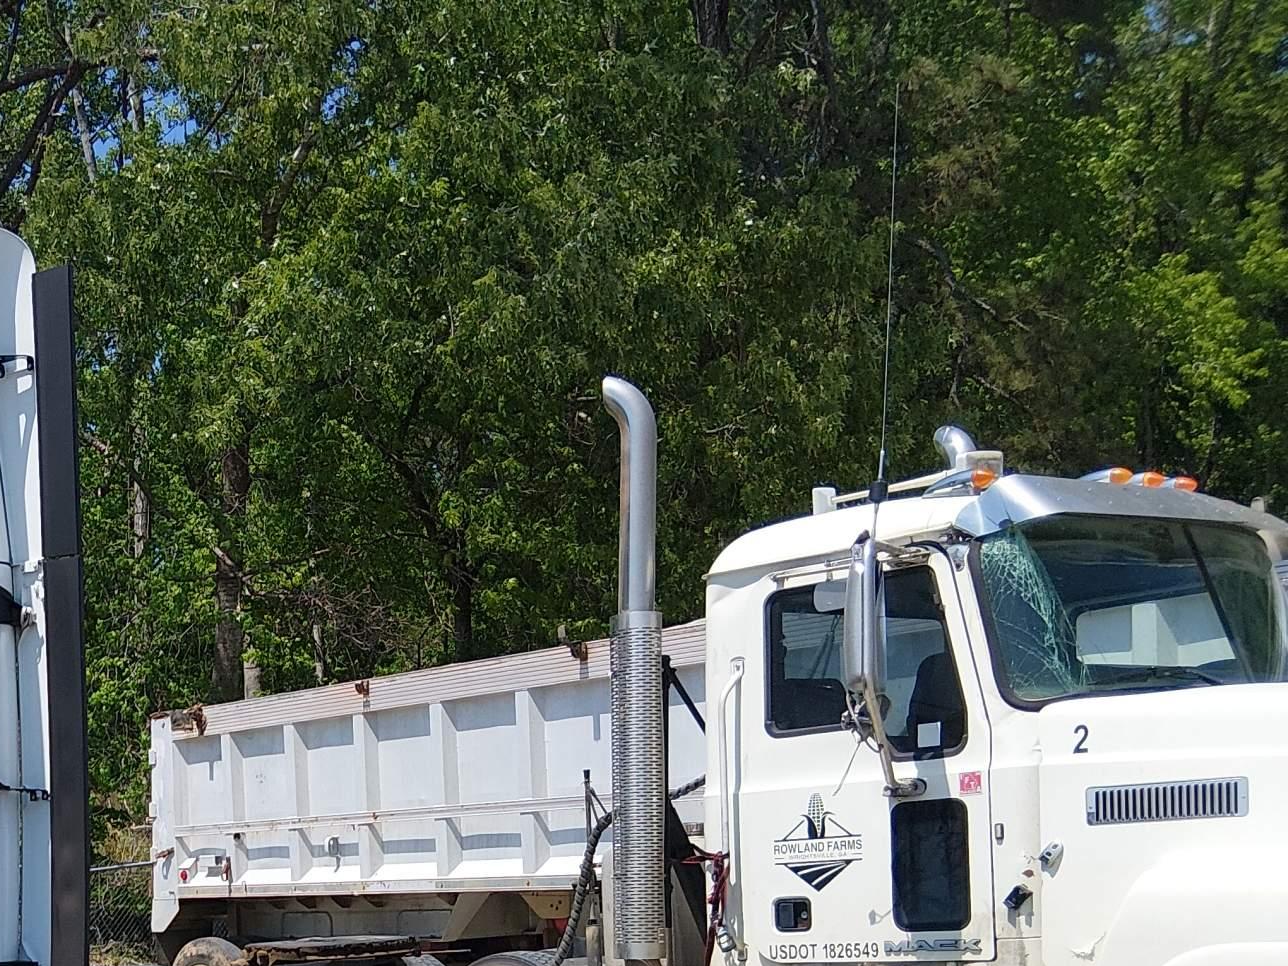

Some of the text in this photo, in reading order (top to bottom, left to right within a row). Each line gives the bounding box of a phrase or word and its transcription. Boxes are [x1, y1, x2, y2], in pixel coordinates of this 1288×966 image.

[1073, 725, 1089, 753] 2
[774, 839, 862, 855] ROWLAND FARMS
[769, 943, 879, 959] USDOT 1826549
[884, 939, 982, 956] MACK
